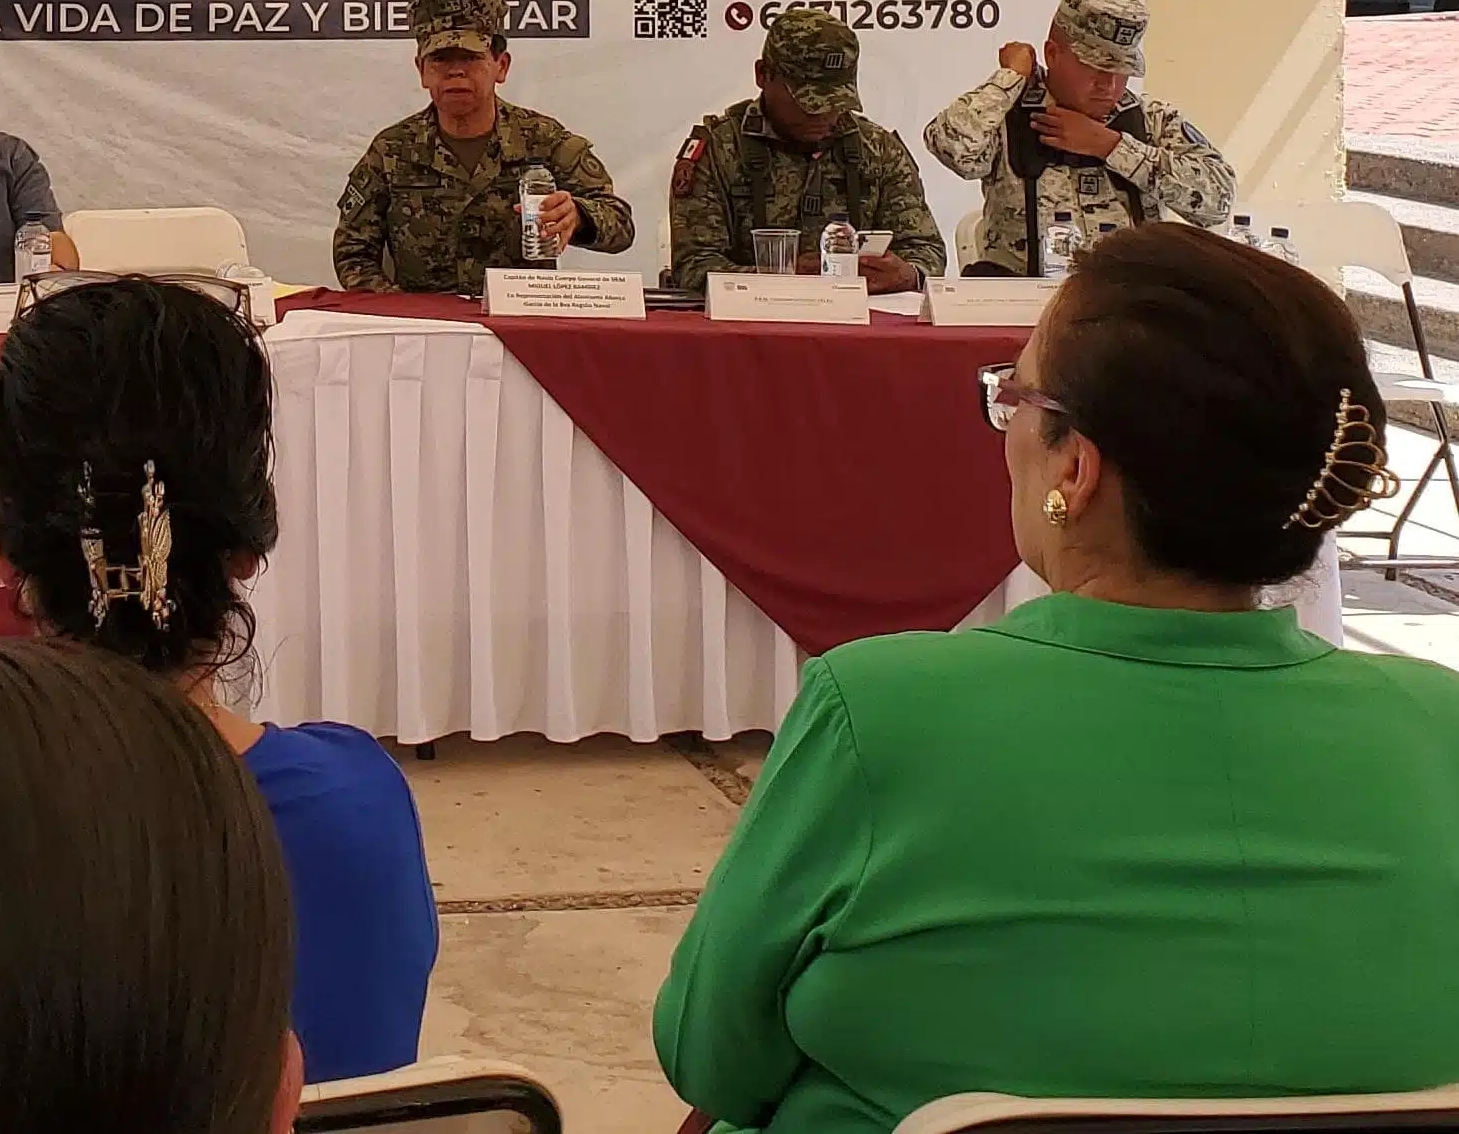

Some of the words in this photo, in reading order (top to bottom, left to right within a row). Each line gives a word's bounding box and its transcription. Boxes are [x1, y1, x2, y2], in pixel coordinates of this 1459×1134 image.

[14, 2, 121, 33] VIDA
[135, 2, 193, 33] DE
[207, 2, 291, 32] PAZ
[301, 2, 330, 32] Y
